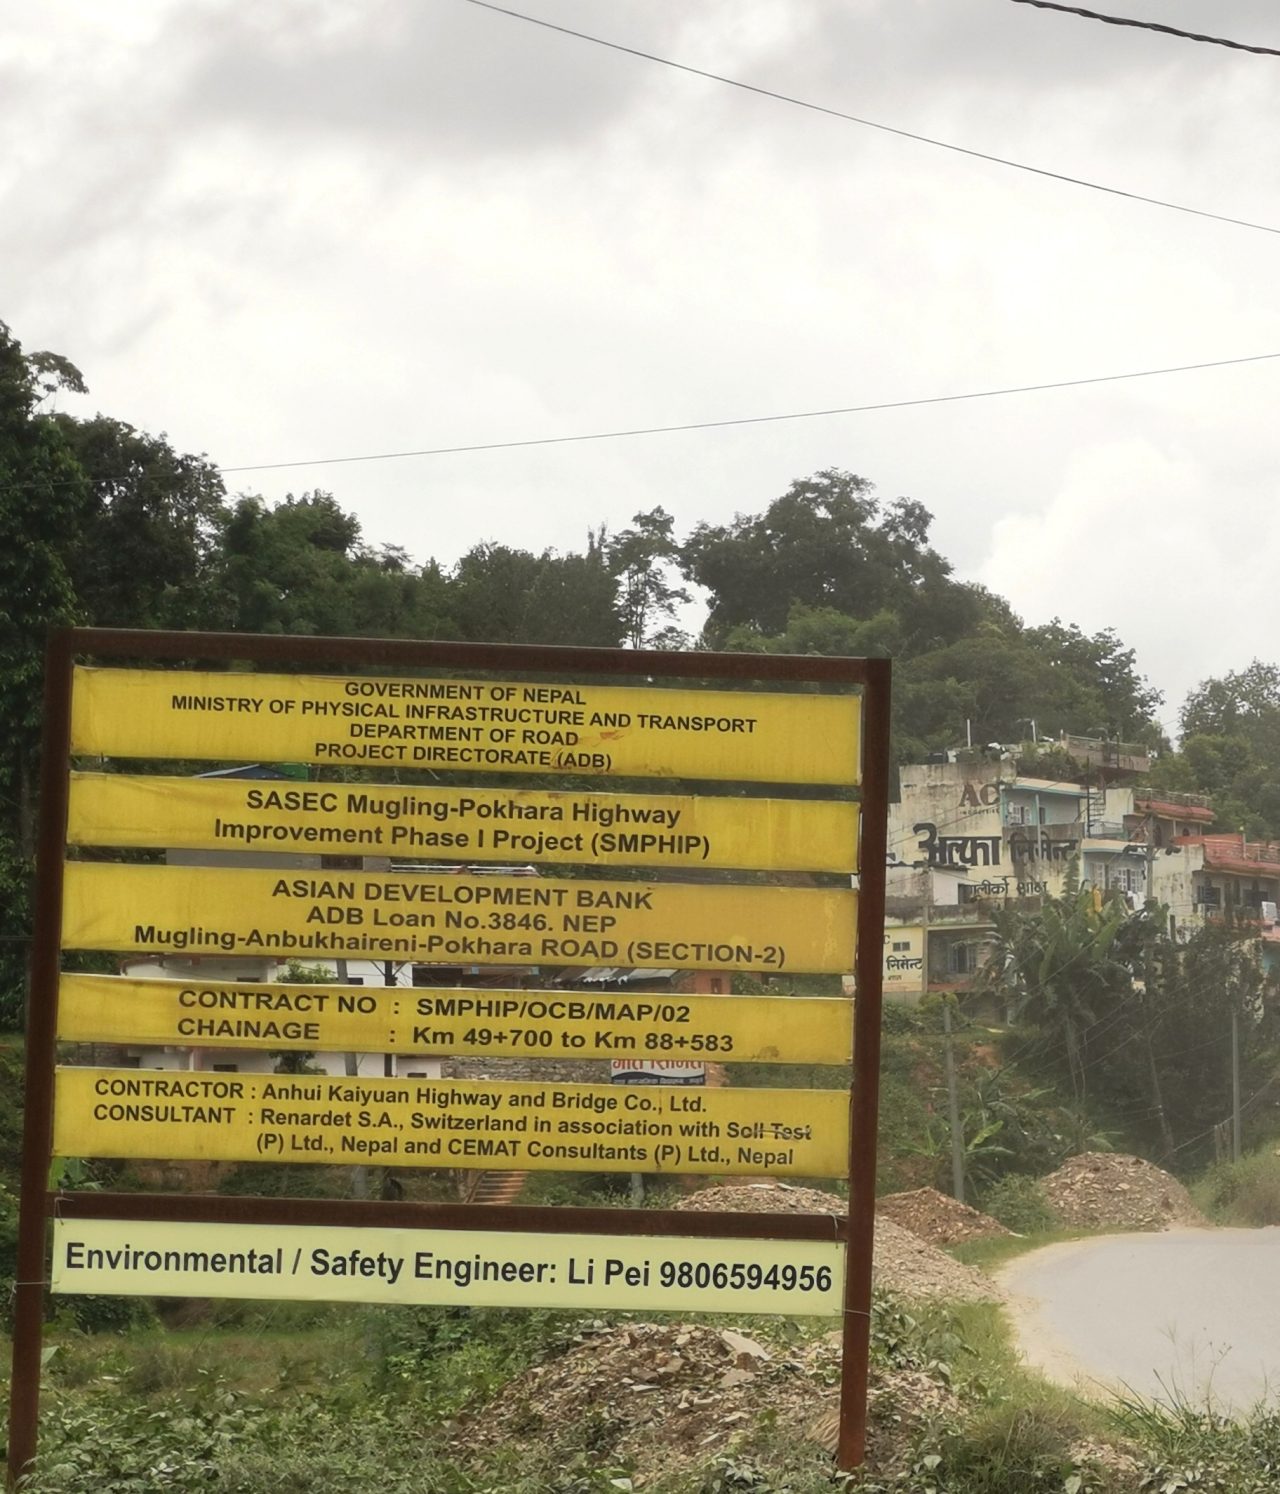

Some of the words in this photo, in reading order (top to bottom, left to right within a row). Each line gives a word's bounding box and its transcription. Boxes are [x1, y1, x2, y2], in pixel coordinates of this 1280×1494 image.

[345, 682, 484, 700] GOVERNMENT
[490, 687, 517, 701] OF
[523, 688, 586, 705] NEPAL
[172, 695, 264, 713] MINISTRY
[269, 700, 296, 714] OF
[302, 701, 400, 718] PHYSICAL
[406, 704, 584, 725] INFRASTRUCTURE
[589, 712, 631, 727] AND
[637, 714, 757, 733] TRANSPORT
[350, 723, 484, 742] DEPARTMENT
[490, 728, 516, 743] OF
[522, 730, 579, 746] ROAD
[315, 743, 407, 760] PROJECT
[414, 746, 551, 765] DIRECTORATE
[557, 752, 611, 772] (ADB)
[247, 790, 337, 812] SASEC
[348, 794, 563, 821] Mugling-Pokhara
[573, 803, 680, 829] Highway
[215, 818, 383, 844] Improvement
[392, 826, 469, 847] Phase
[478, 829, 484, 848] I
[493, 830, 583, 855] Project
[591, 833, 709, 860] (SMPHIP)
[272, 880, 354, 899] ASIAN
[365, 883, 568, 906] DEVELOPMENT
[577, 890, 652, 910] BANK
[306, 906, 363, 925] ADB
[374, 908, 435, 927] Loan
[445, 911, 553, 931] No.3846.
[563, 915, 616, 933] NEP
[135, 925, 532, 955] Mugling-Anbukhaireni-Pokhara
[542, 939, 618, 958] ROAD
[628, 941, 785, 968] (SECTION-2)
[179, 990, 330, 1012] CONTRACT
[338, 996, 376, 1014] NO
[417, 998, 690, 1022] SMPHIP/OCB/MAP/02
[178, 1018, 320, 1040] CHAINAGE
[413, 1026, 454, 1044] Km
[463, 1028, 552, 1047] 49+700
[561, 1032, 586, 1048] to
[595, 1031, 635, 1049] Km
[645, 1033, 733, 1052] 88+583
[95, 1079, 244, 1099] CONTRACTOR
[262, 1083, 321, 1101] Anhui
[329, 1085, 409, 1106] Kaiyuan
[417, 1088, 502, 1110] Highway
[508, 1091, 545, 1107] and
[552, 1092, 617, 1113] Bridge
[624, 1094, 662, 1115] Co.,
[670, 1096, 706, 1112] Ltd.
[94, 1104, 236, 1124] CONSULTANT
[261, 1108, 352, 1127] Renardet
[358, 1111, 403, 1131] S.A.,
[411, 1112, 527, 1132] Switzerland
[534, 1116, 551, 1132] in
[558, 1118, 672, 1136] association
[679, 1121, 720, 1137] with
[770, 1122, 812, 1140] Test
[257, 1133, 284, 1154] (P)
[292, 1134, 333, 1154] Ltd.,
[342, 1136, 397, 1156] Nepal
[404, 1138, 441, 1154] and
[448, 1138, 521, 1156] CEMAT
[527, 1141, 647, 1160] Consultants
[654, 1144, 681, 1168] (P)
[688, 1146, 730, 1165] Ltd.,
[738, 1147, 793, 1168] Nepal
[66, 1242, 282, 1274] Environmental
[292, 1248, 302, 1275] /
[311, 1249, 404, 1284] Safety
[415, 1252, 556, 1287] Engineer:
[569, 1258, 594, 1284] Li
[605, 1259, 650, 1286] Pei
[660, 1261, 831, 1292] 9806594956
